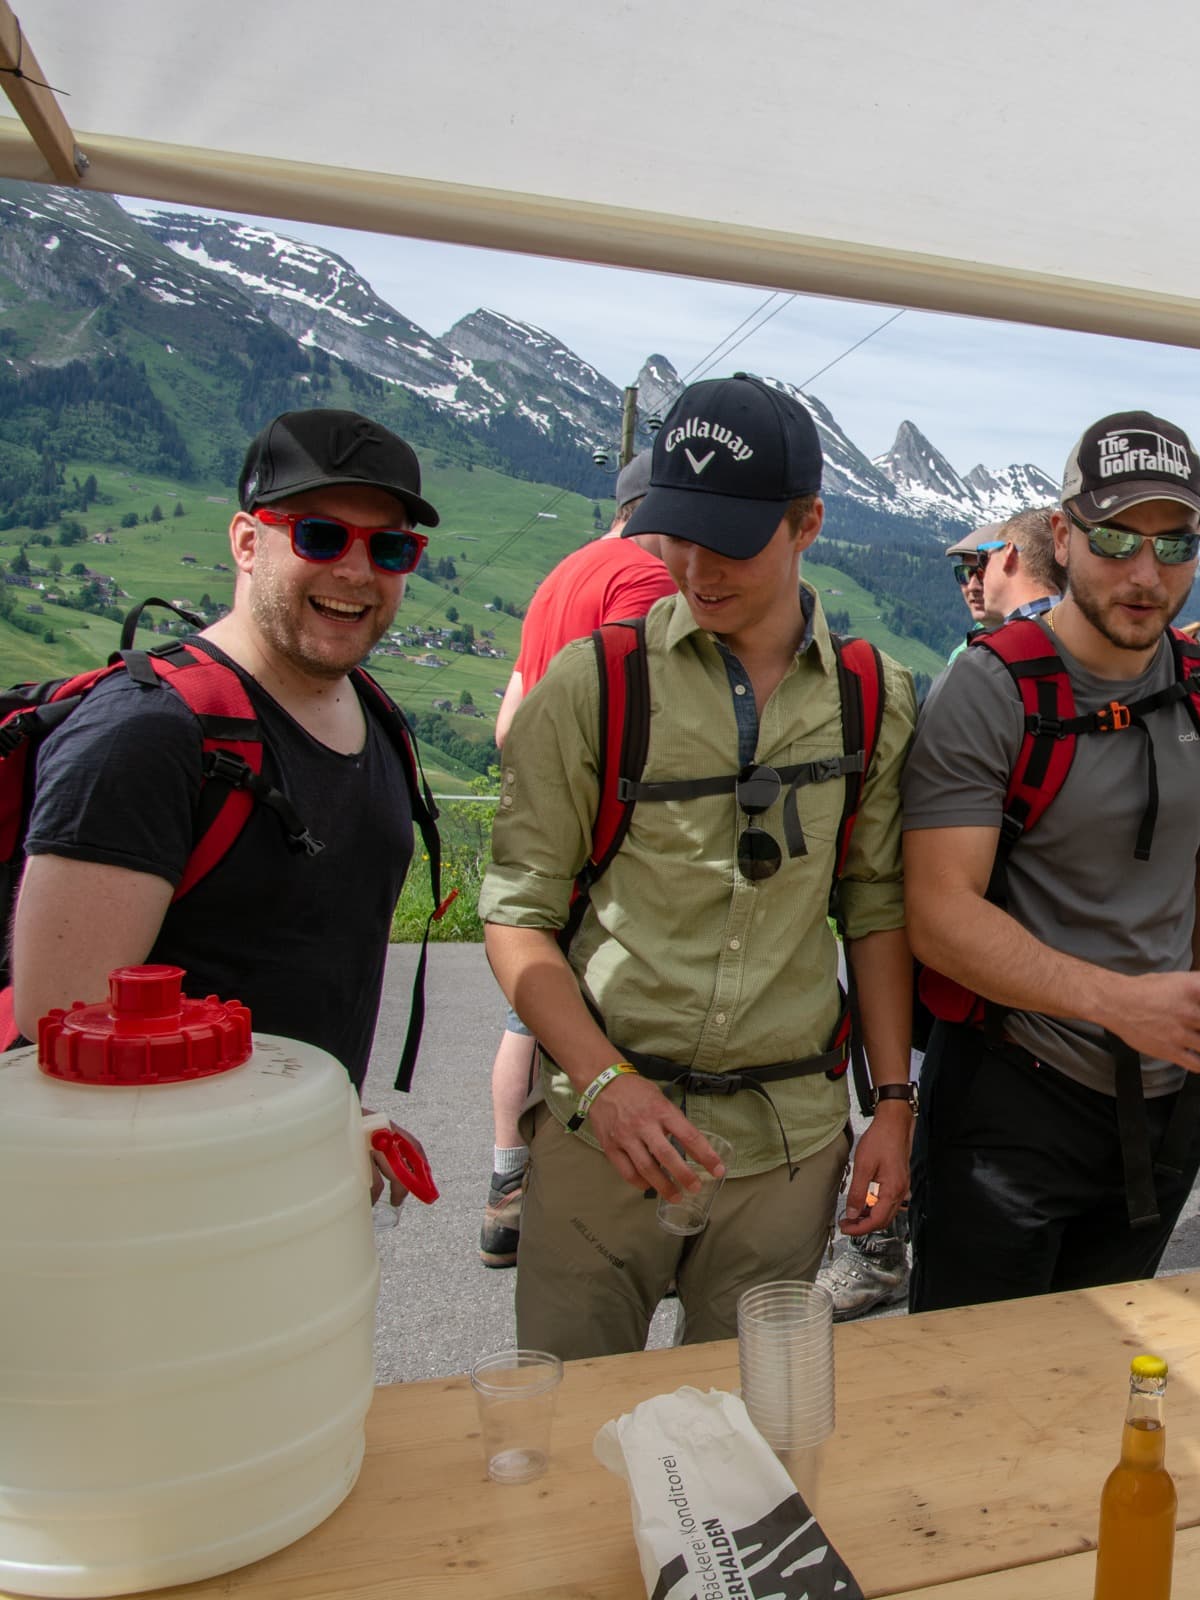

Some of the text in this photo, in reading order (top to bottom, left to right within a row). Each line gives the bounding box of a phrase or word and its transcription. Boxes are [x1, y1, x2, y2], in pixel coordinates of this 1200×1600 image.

[665, 417, 753, 461] Callaway
[1098, 436, 1130, 456] The
[1099, 448, 1192, 480] Golffather
